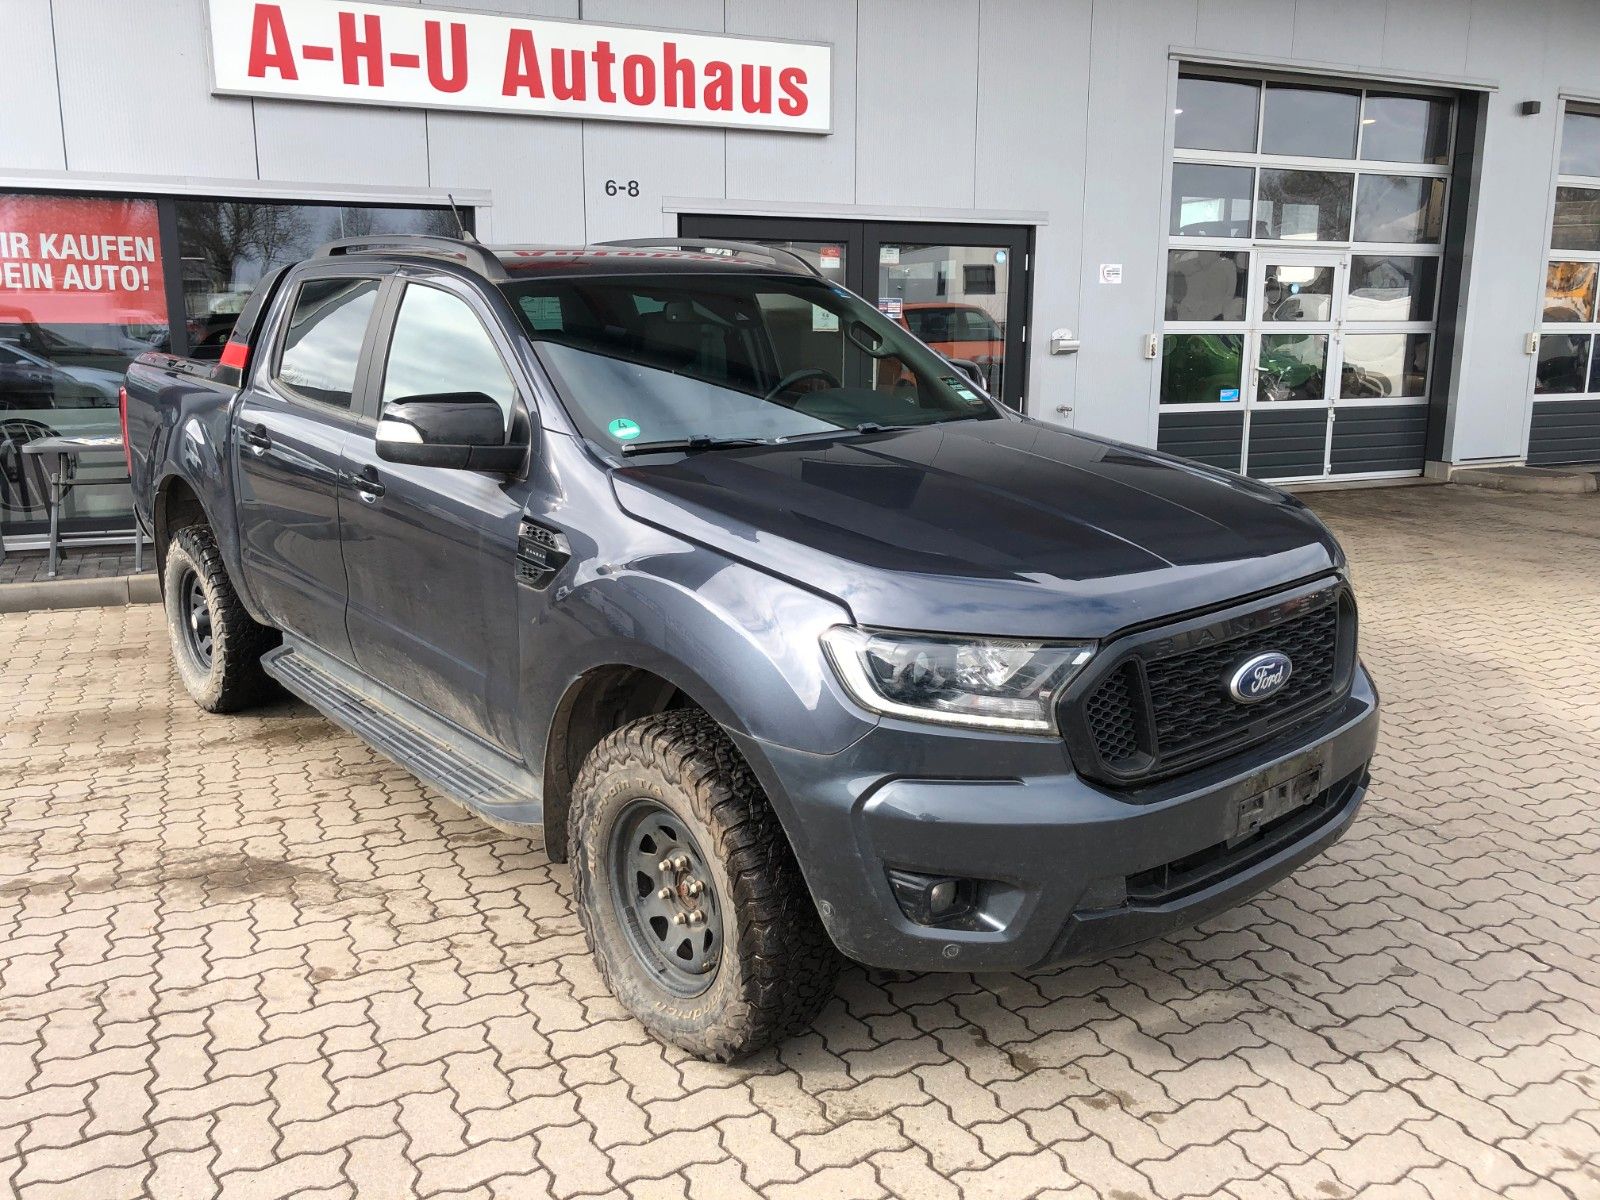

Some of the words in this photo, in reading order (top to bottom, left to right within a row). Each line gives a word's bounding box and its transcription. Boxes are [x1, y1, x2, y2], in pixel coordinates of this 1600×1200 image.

[248, 3, 469, 93] A-H-U
[502, 29, 809, 117] Autohaus
[605, 180, 640, 197] 6-8
[0, 231, 30, 259] IR
[39, 232, 155, 262] KAUFEN
[0, 262, 53, 289] EIN
[63, 263, 149, 291] AUTO!
[1251, 662, 1284, 693] Ford
